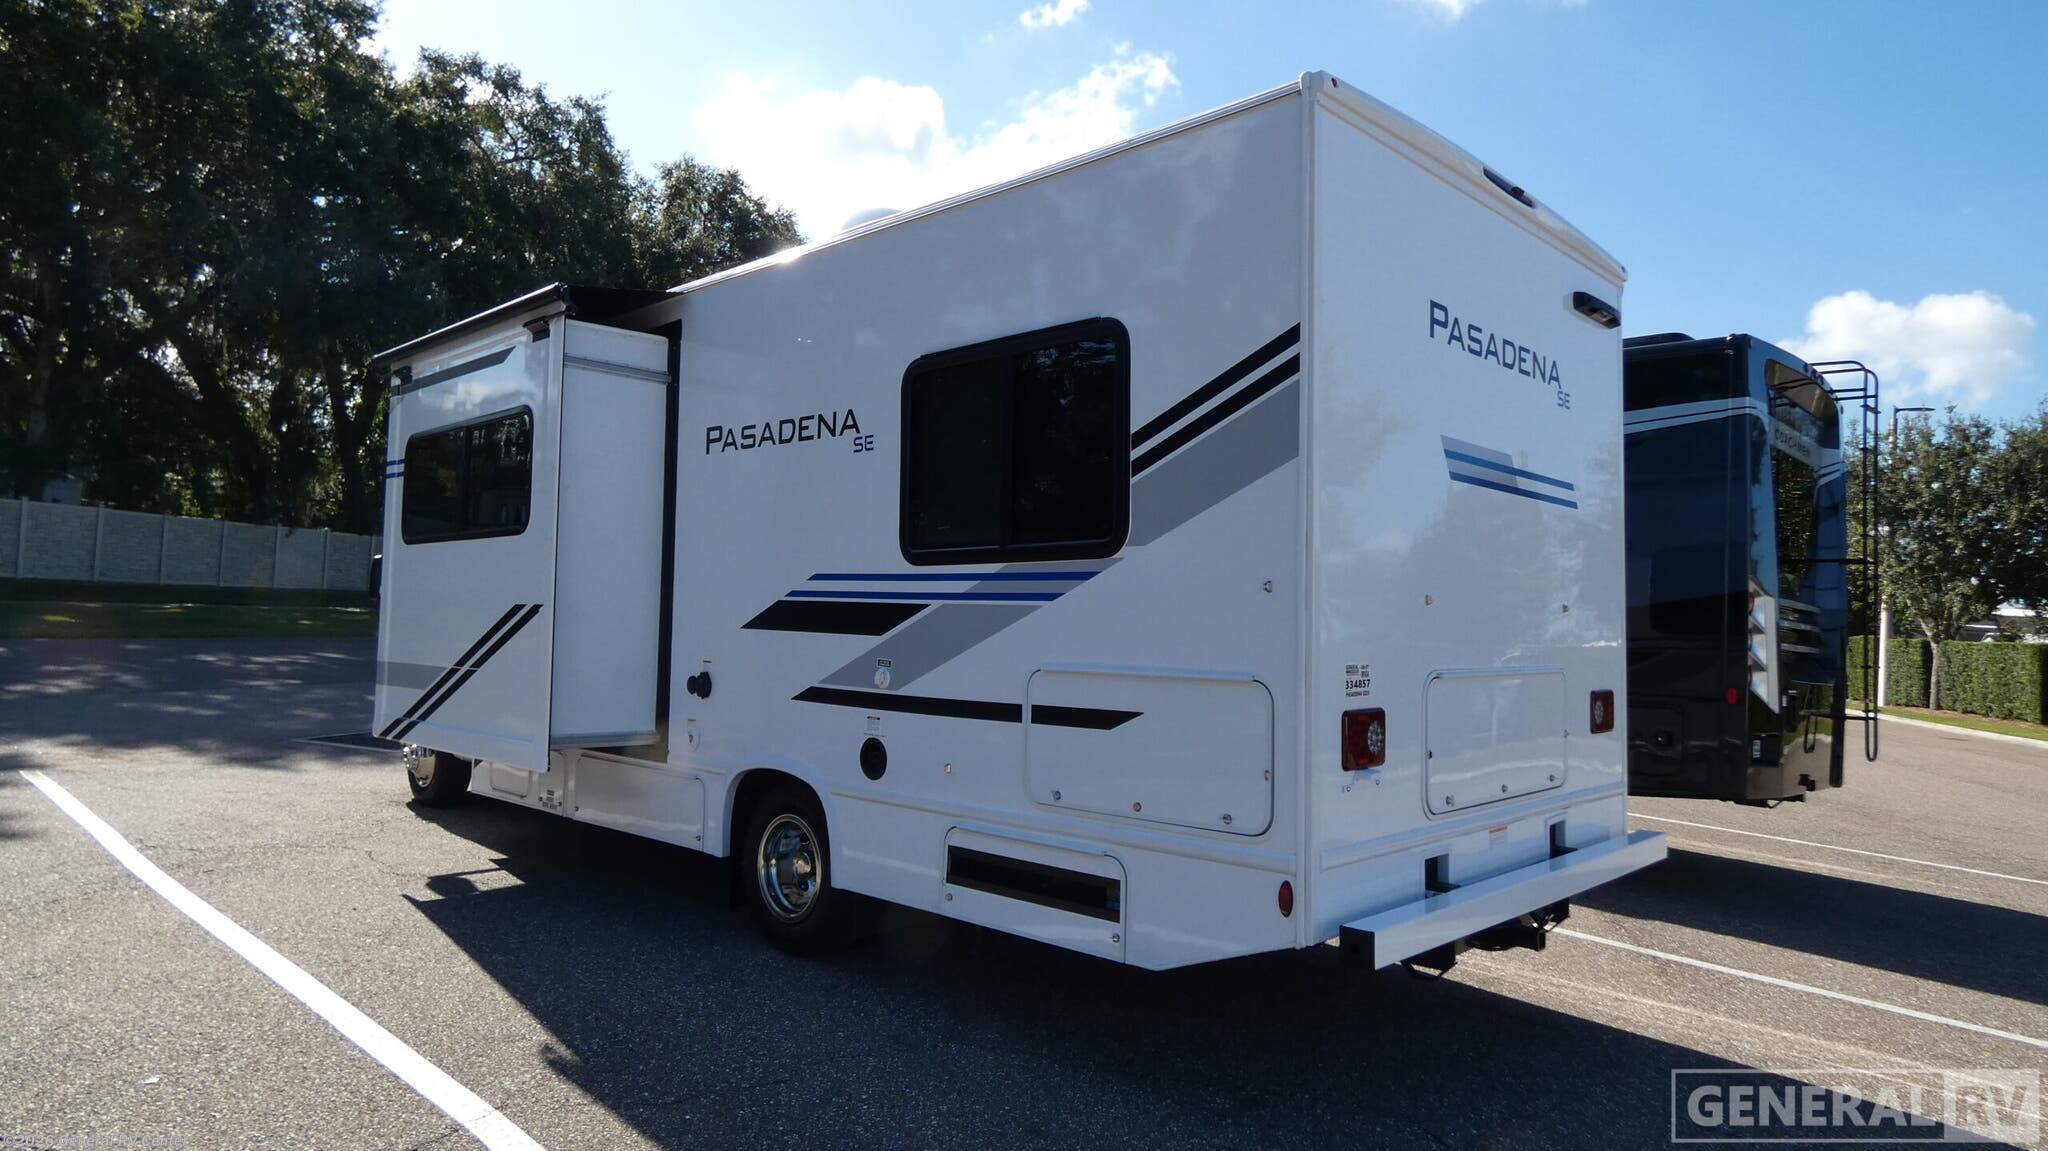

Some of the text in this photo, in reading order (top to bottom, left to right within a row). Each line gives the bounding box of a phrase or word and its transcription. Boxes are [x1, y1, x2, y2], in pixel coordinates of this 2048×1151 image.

[1429, 299, 1562, 390] PASADENA
[1557, 390, 1571, 410] SE
[705, 408, 861, 455] PASADENA
[852, 434, 875, 453] SE
[1345, 679, 1371, 690] 334857
